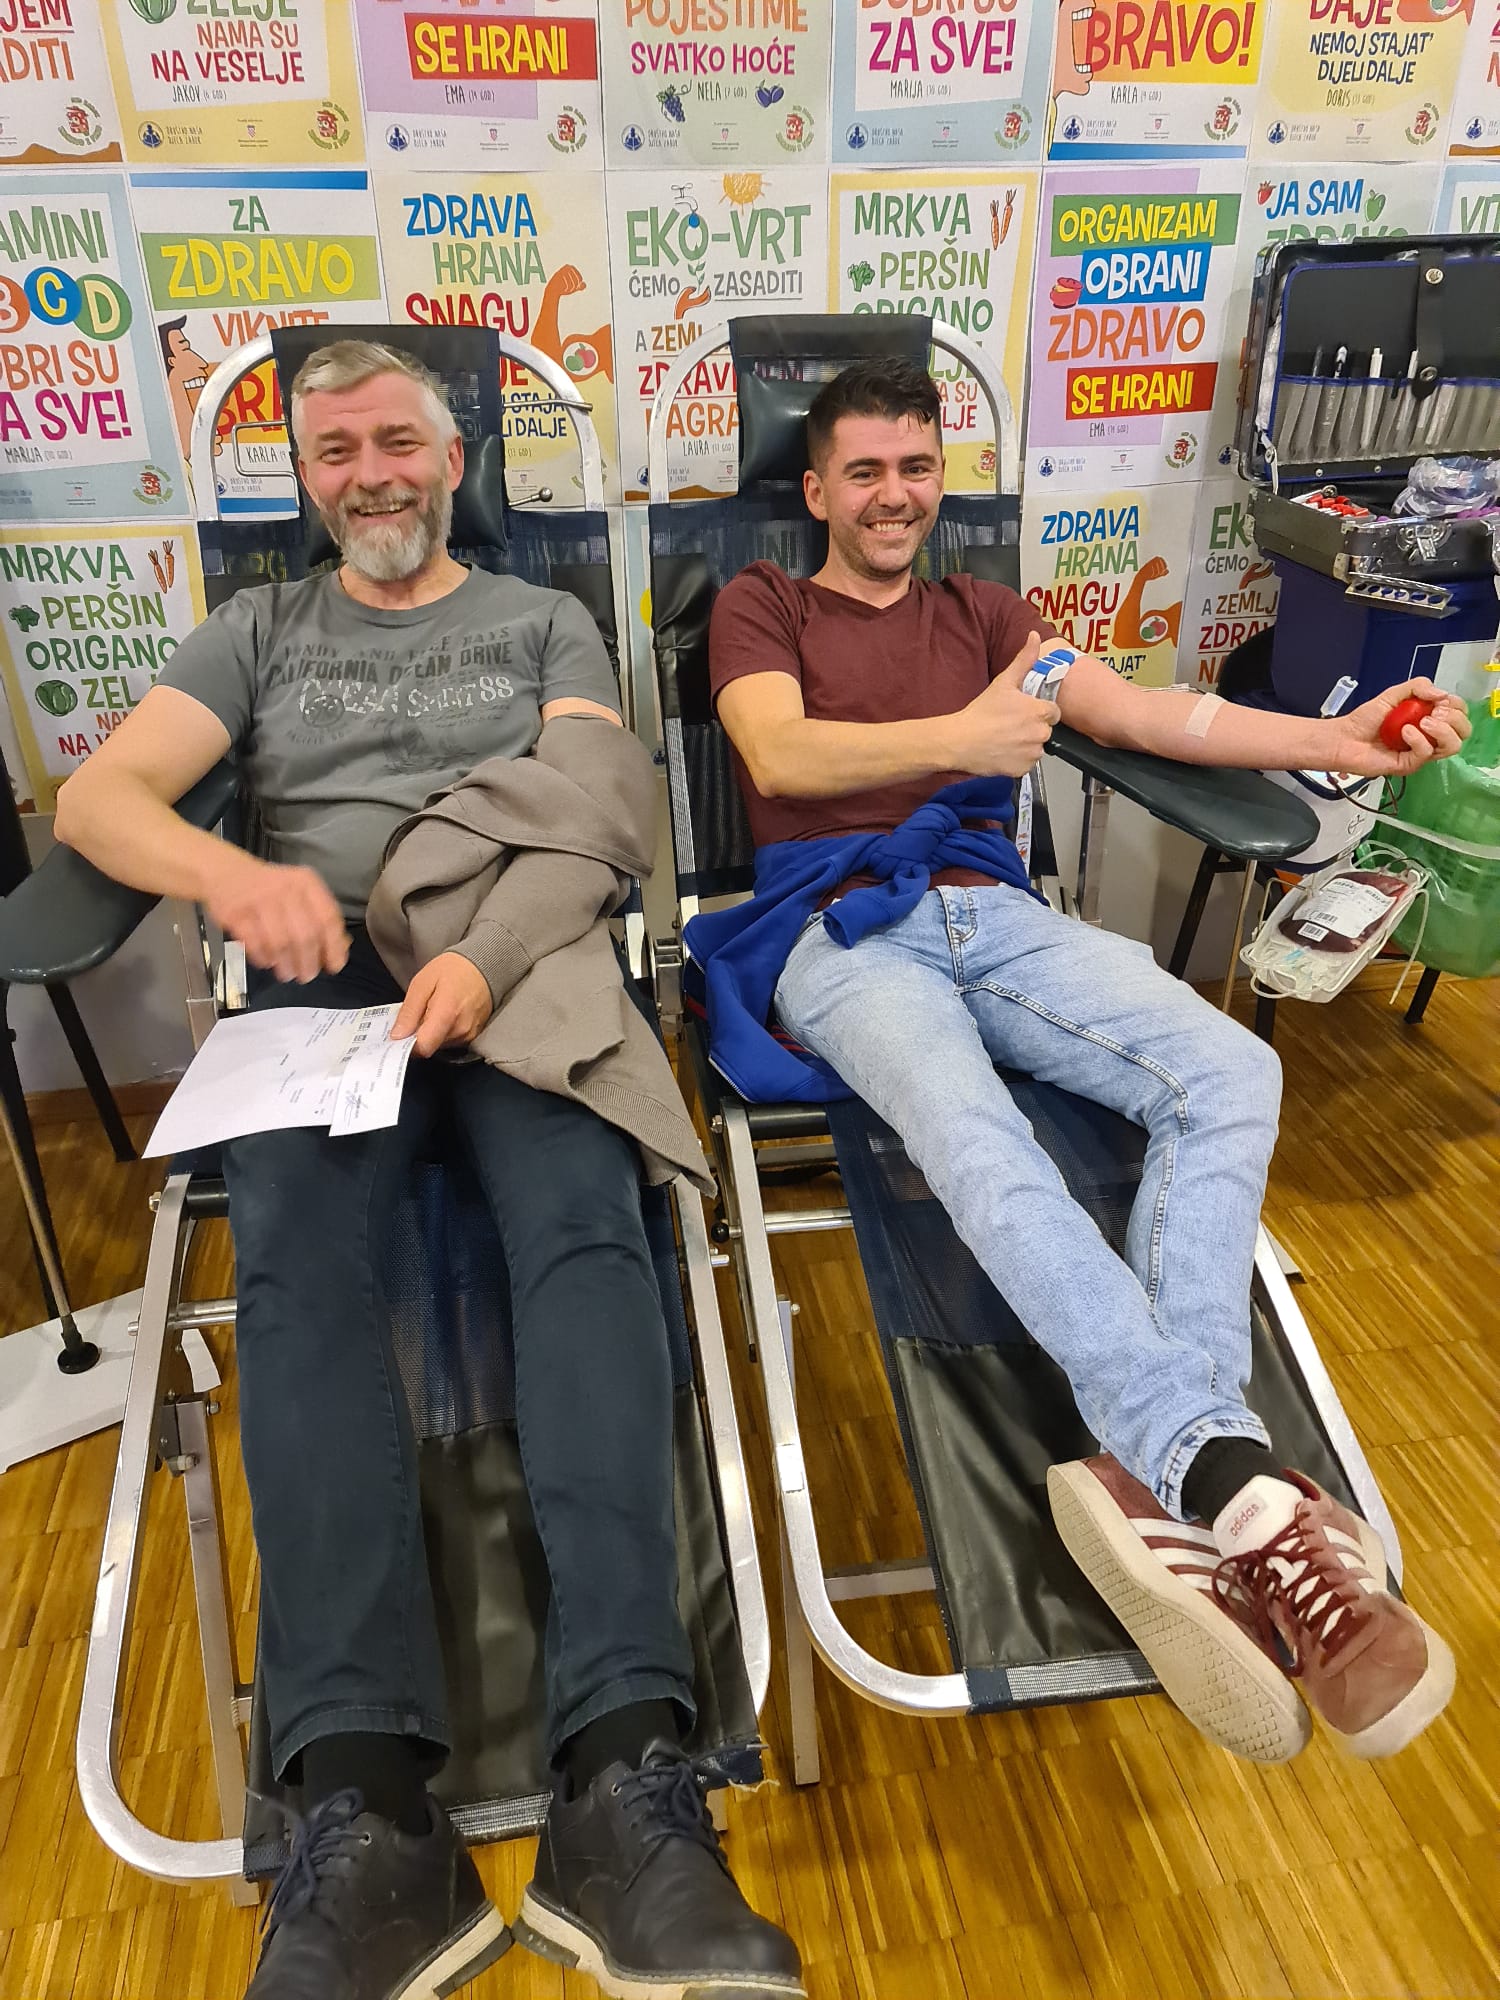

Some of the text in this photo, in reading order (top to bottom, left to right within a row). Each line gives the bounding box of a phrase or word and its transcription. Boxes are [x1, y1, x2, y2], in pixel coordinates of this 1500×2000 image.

[196, 20, 299, 49] NAMA SU
[414, 21, 568, 75] SE HRANI
[869, 16, 1017, 75] ZA SVE!
[1085, 0, 1256, 73] BRAVO!
[1310, 31, 1366, 57] NEMOJ
[151, 50, 305, 84] NA VESELJE
[631, 36, 796, 76] SVATKO HOĆE
[1317, 59, 1417, 85] DIJELI DALJE
[172, 86, 200, 103] JAKOV
[445, 85, 466, 104] EMA
[697, 81, 722, 101] NELA
[890, 79, 923, 99] MARIJA
[1110, 85, 1138, 105] KARLA
[1326, 89, 1351, 107] DORIS
[228, 196, 271, 232] ZA
[402, 193, 538, 239] ZDRAVA
[854, 192, 971, 238] MRKVA
[1266, 178, 1364, 220] JA SAM
[626, 205, 811, 267] EKO-VRT
[1059, 199, 1218, 245] ORGANIZAM
[160, 238, 355, 301] ZDRAVO
[432, 241, 548, 286] HRANA
[880, 237, 990, 291] PERŠIN
[1085, 250, 1203, 300] OBRANI
[628, 270, 803, 298] ĆEMO ZASADITI
[405, 292, 530, 338] SNAGU
[635, 322, 703, 352] A ZEM
[1047, 306, 1206, 362] ZDRAVO
[0, 340, 119, 391] BRI SU
[955, 381, 978, 403] SU
[1071, 369, 1195, 415] SE HRANI
[35, 389, 132, 440] SVE!
[515, 417, 567, 438] DALJE
[645, 401, 739, 439] AGRA
[1089, 422, 1105, 438] EMA
[246, 446, 281, 463] KARLA
[682, 440, 710, 457] LAURA
[1041, 505, 1139, 545] ZDRAVA
[0, 544, 136, 585] MRKVA
[1054, 540, 1139, 580] HRANA
[1205, 552, 1249, 575] ĆEMO
[41, 582, 168, 631] PERŠIN
[1026, 580, 1120, 620] SNAGU
[1201, 599, 1212, 616] A
[26, 634, 180, 673] ORIGANO
[1052, 618, 1111, 654] AJE
[1198, 621, 1269, 650] ZDRA
[460, 641, 513, 667] DRIVE
[1096, 655, 1147, 674] AJAT'
[81, 674, 157, 709] ZEL
[96, 711, 129, 731] NA
[58, 733, 92, 756] NA
[1229, 1503, 1260, 1537] adidas
